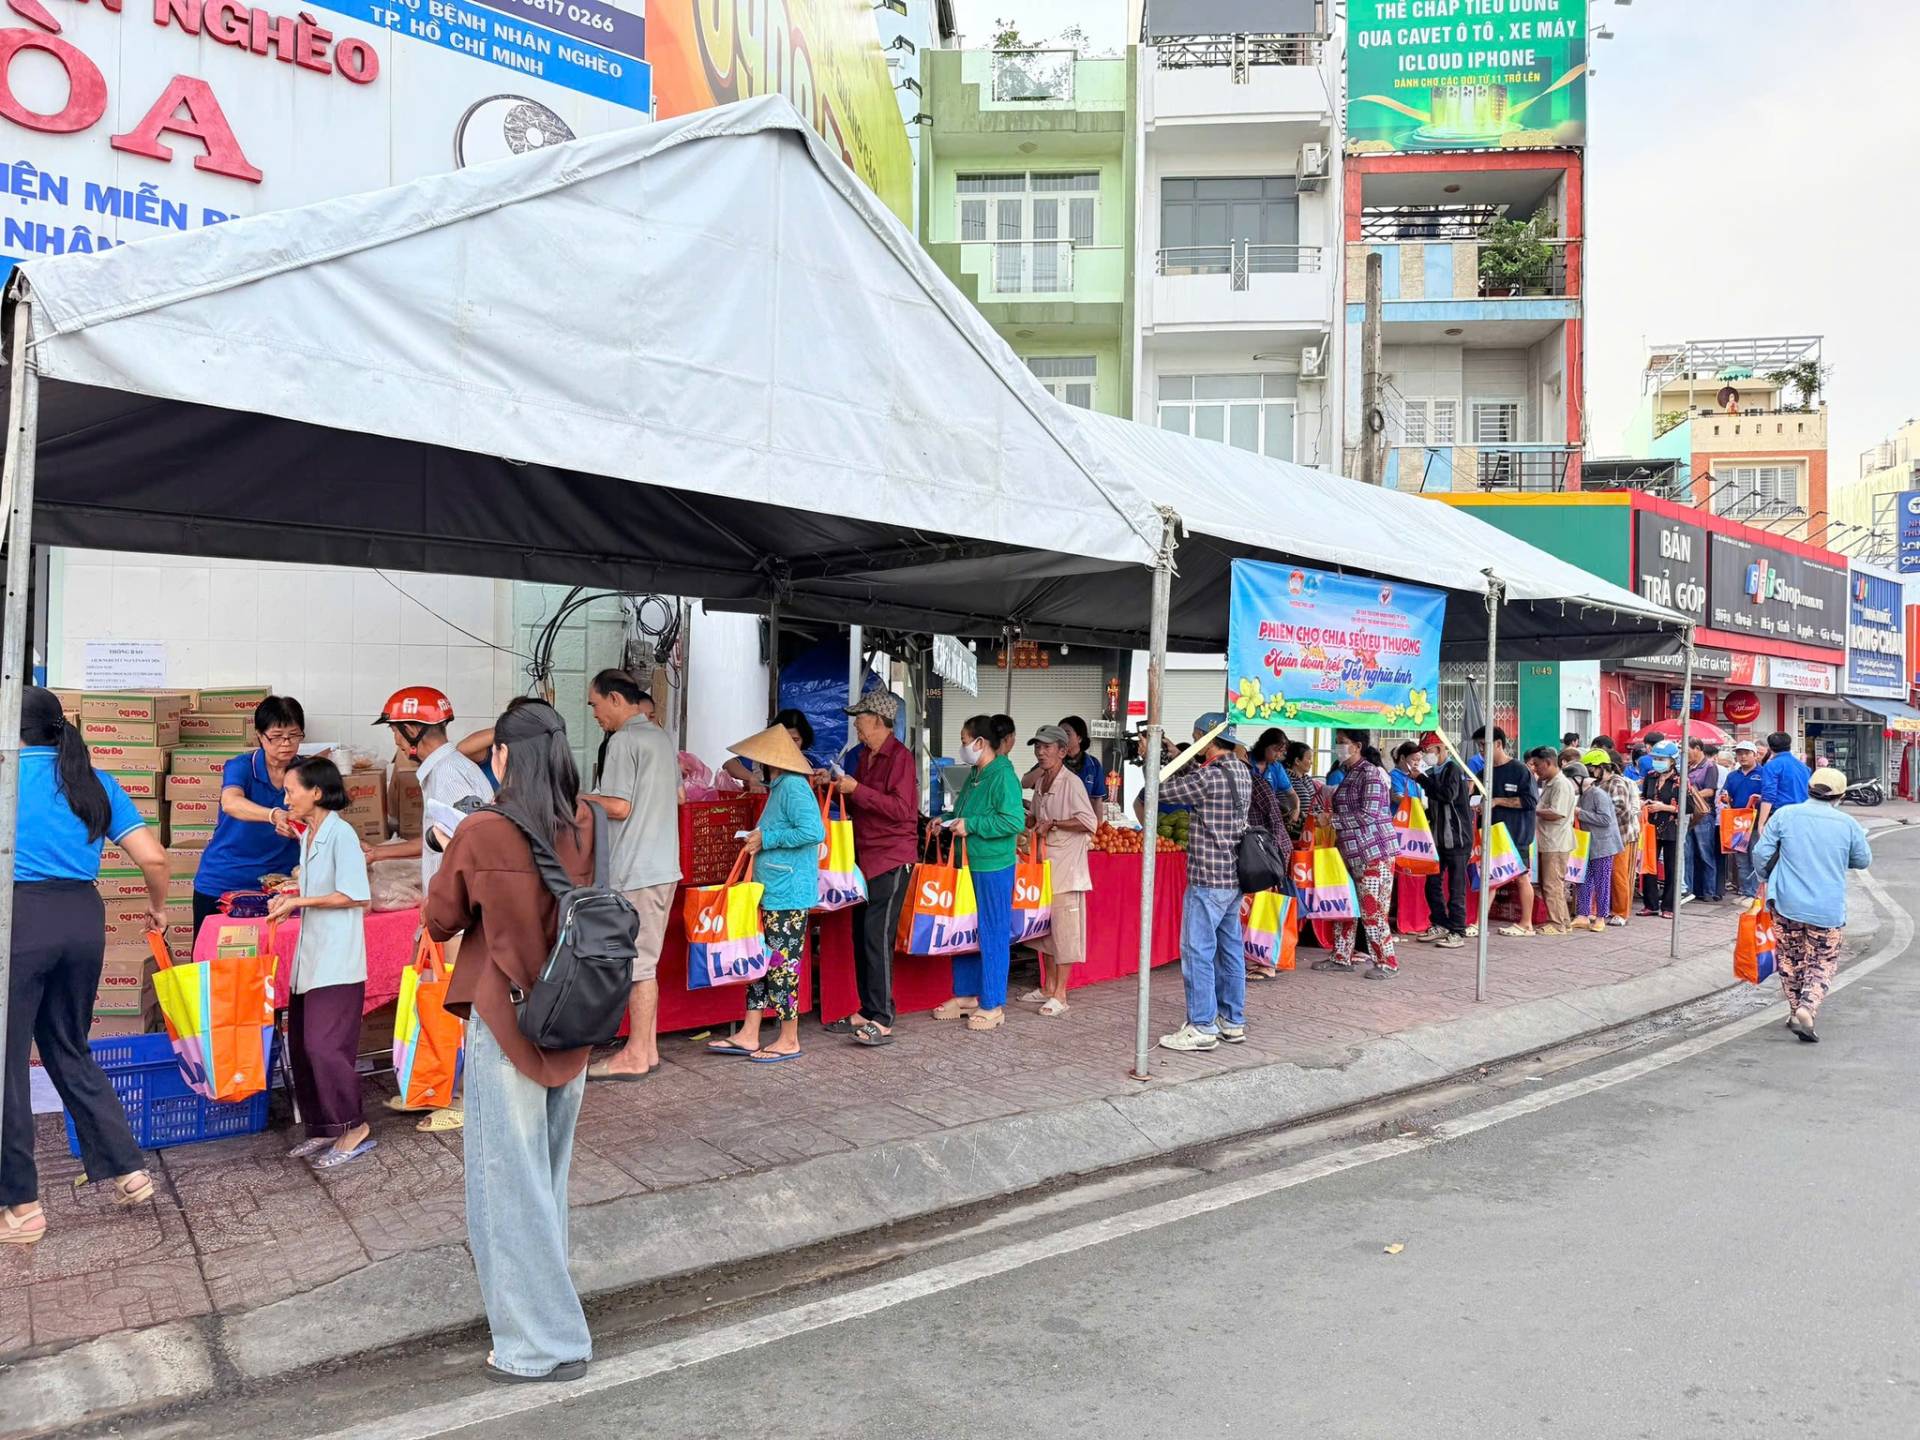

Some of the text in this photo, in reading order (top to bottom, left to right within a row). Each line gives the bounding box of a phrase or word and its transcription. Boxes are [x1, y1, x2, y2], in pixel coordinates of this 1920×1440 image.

[567, 4, 614, 33] 0266
[1358, 31, 1393, 48] QUA
[1397, 27, 1452, 46] CAVET
[1456, 22, 1468, 42] Ô
[1472, 21, 1494, 42] TÔ
[1509, 22, 1532, 40] XE
[1537, 17, 1577, 39] MÁY
[369, 5, 544, 76] TP. HỒ CHÍ MINH
[428, 0, 486, 33] BỆNH
[493, 22, 551, 55] NHÂN
[557, 45, 623, 79] NGHÈO
[1398, 49, 1536, 72] ICLOUD IPHONE
[1492, 74, 1501, 84] 11
[1523, 71, 1541, 83] LÊN
[85, 182, 188, 231] MIỄN
[1660, 526, 1691, 563] BÁN
[1641, 568, 1706, 613] TRẢ GÓP
[1322, 629, 1347, 648] CHIA
[1531, 666, 1552, 676] 1049
[926, 688, 941, 696] 1045
[920, 880, 953, 909] So
[1015, 877, 1040, 901] So
[694, 905, 724, 935] So
